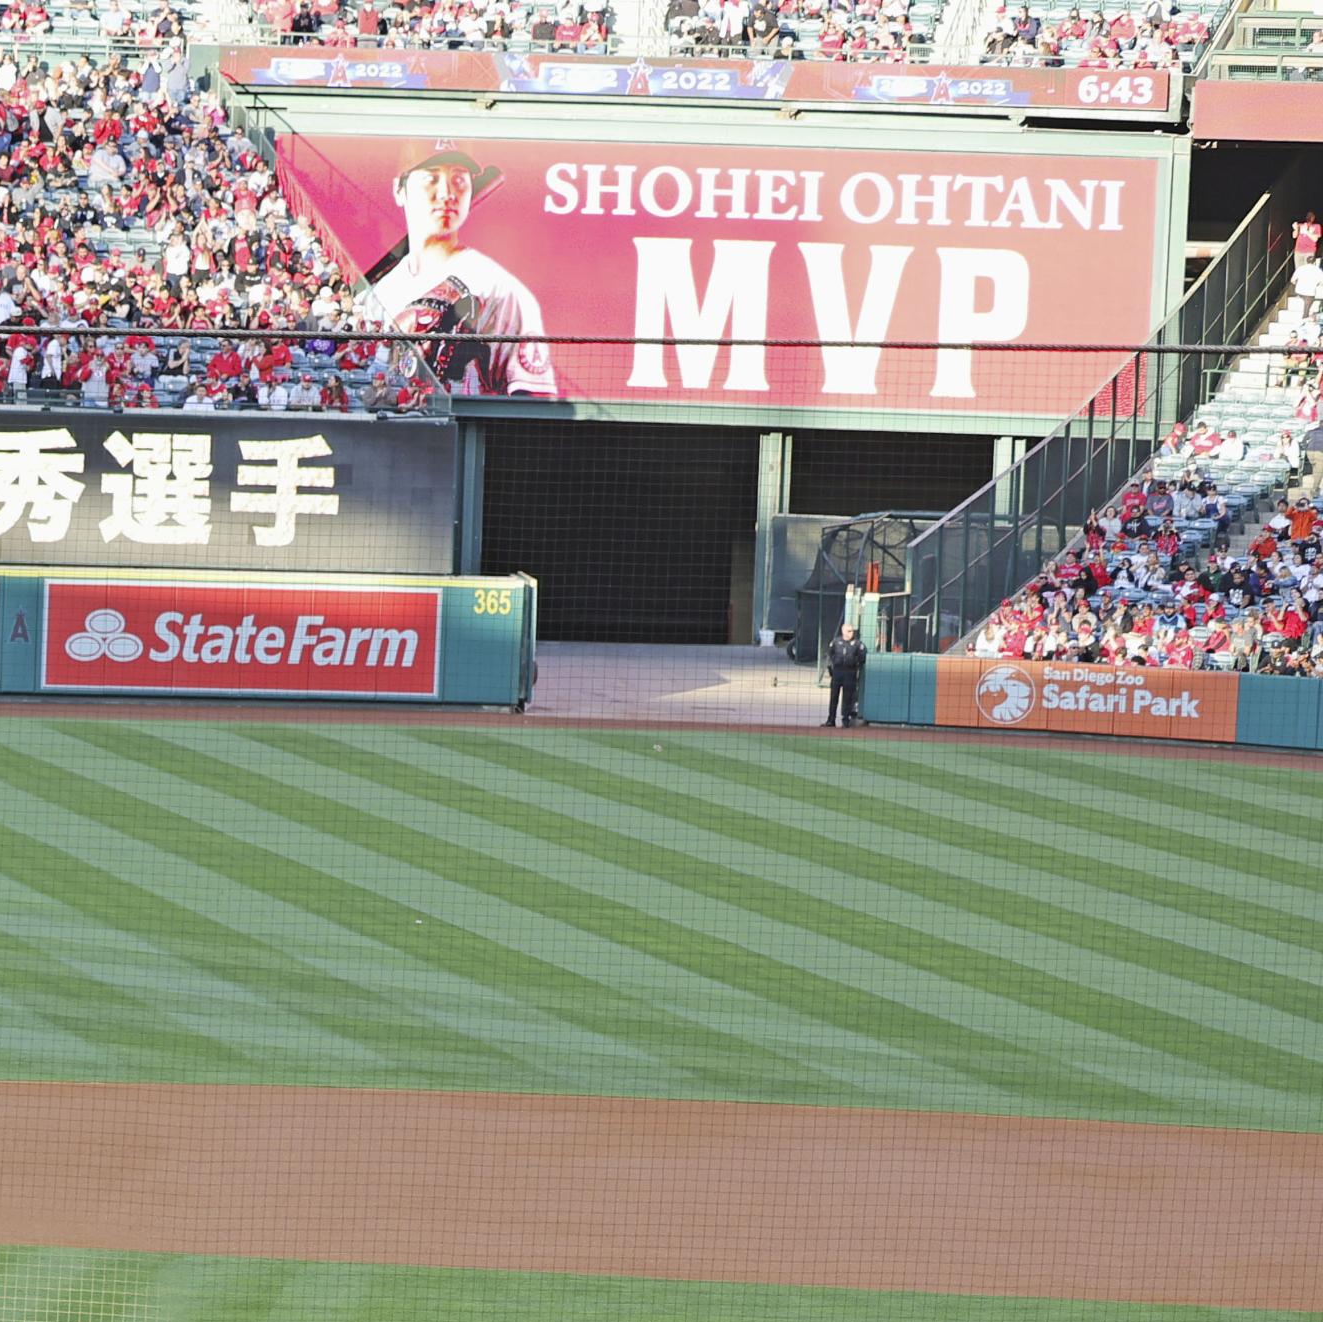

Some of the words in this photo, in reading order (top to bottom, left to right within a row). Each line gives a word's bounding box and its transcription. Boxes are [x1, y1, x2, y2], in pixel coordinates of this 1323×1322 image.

[355, 63, 403, 78] 2022
[662, 71, 731, 91] 2022
[957, 80, 1007, 96] 2022
[1077, 75, 1154, 106] 6:43
[544, 163, 825, 223] SHOHEI
[840, 171, 1126, 232] OHTANI
[626, 236, 1031, 398] MVP
[473, 589, 512, 615] 365
[1043, 666, 1070, 682] San
[1074, 668, 1114, 686] Diego
[1116, 671, 1145, 686] Zoo
[1042, 683, 1128, 714] Safari
[1133, 689, 1200, 718] Park
